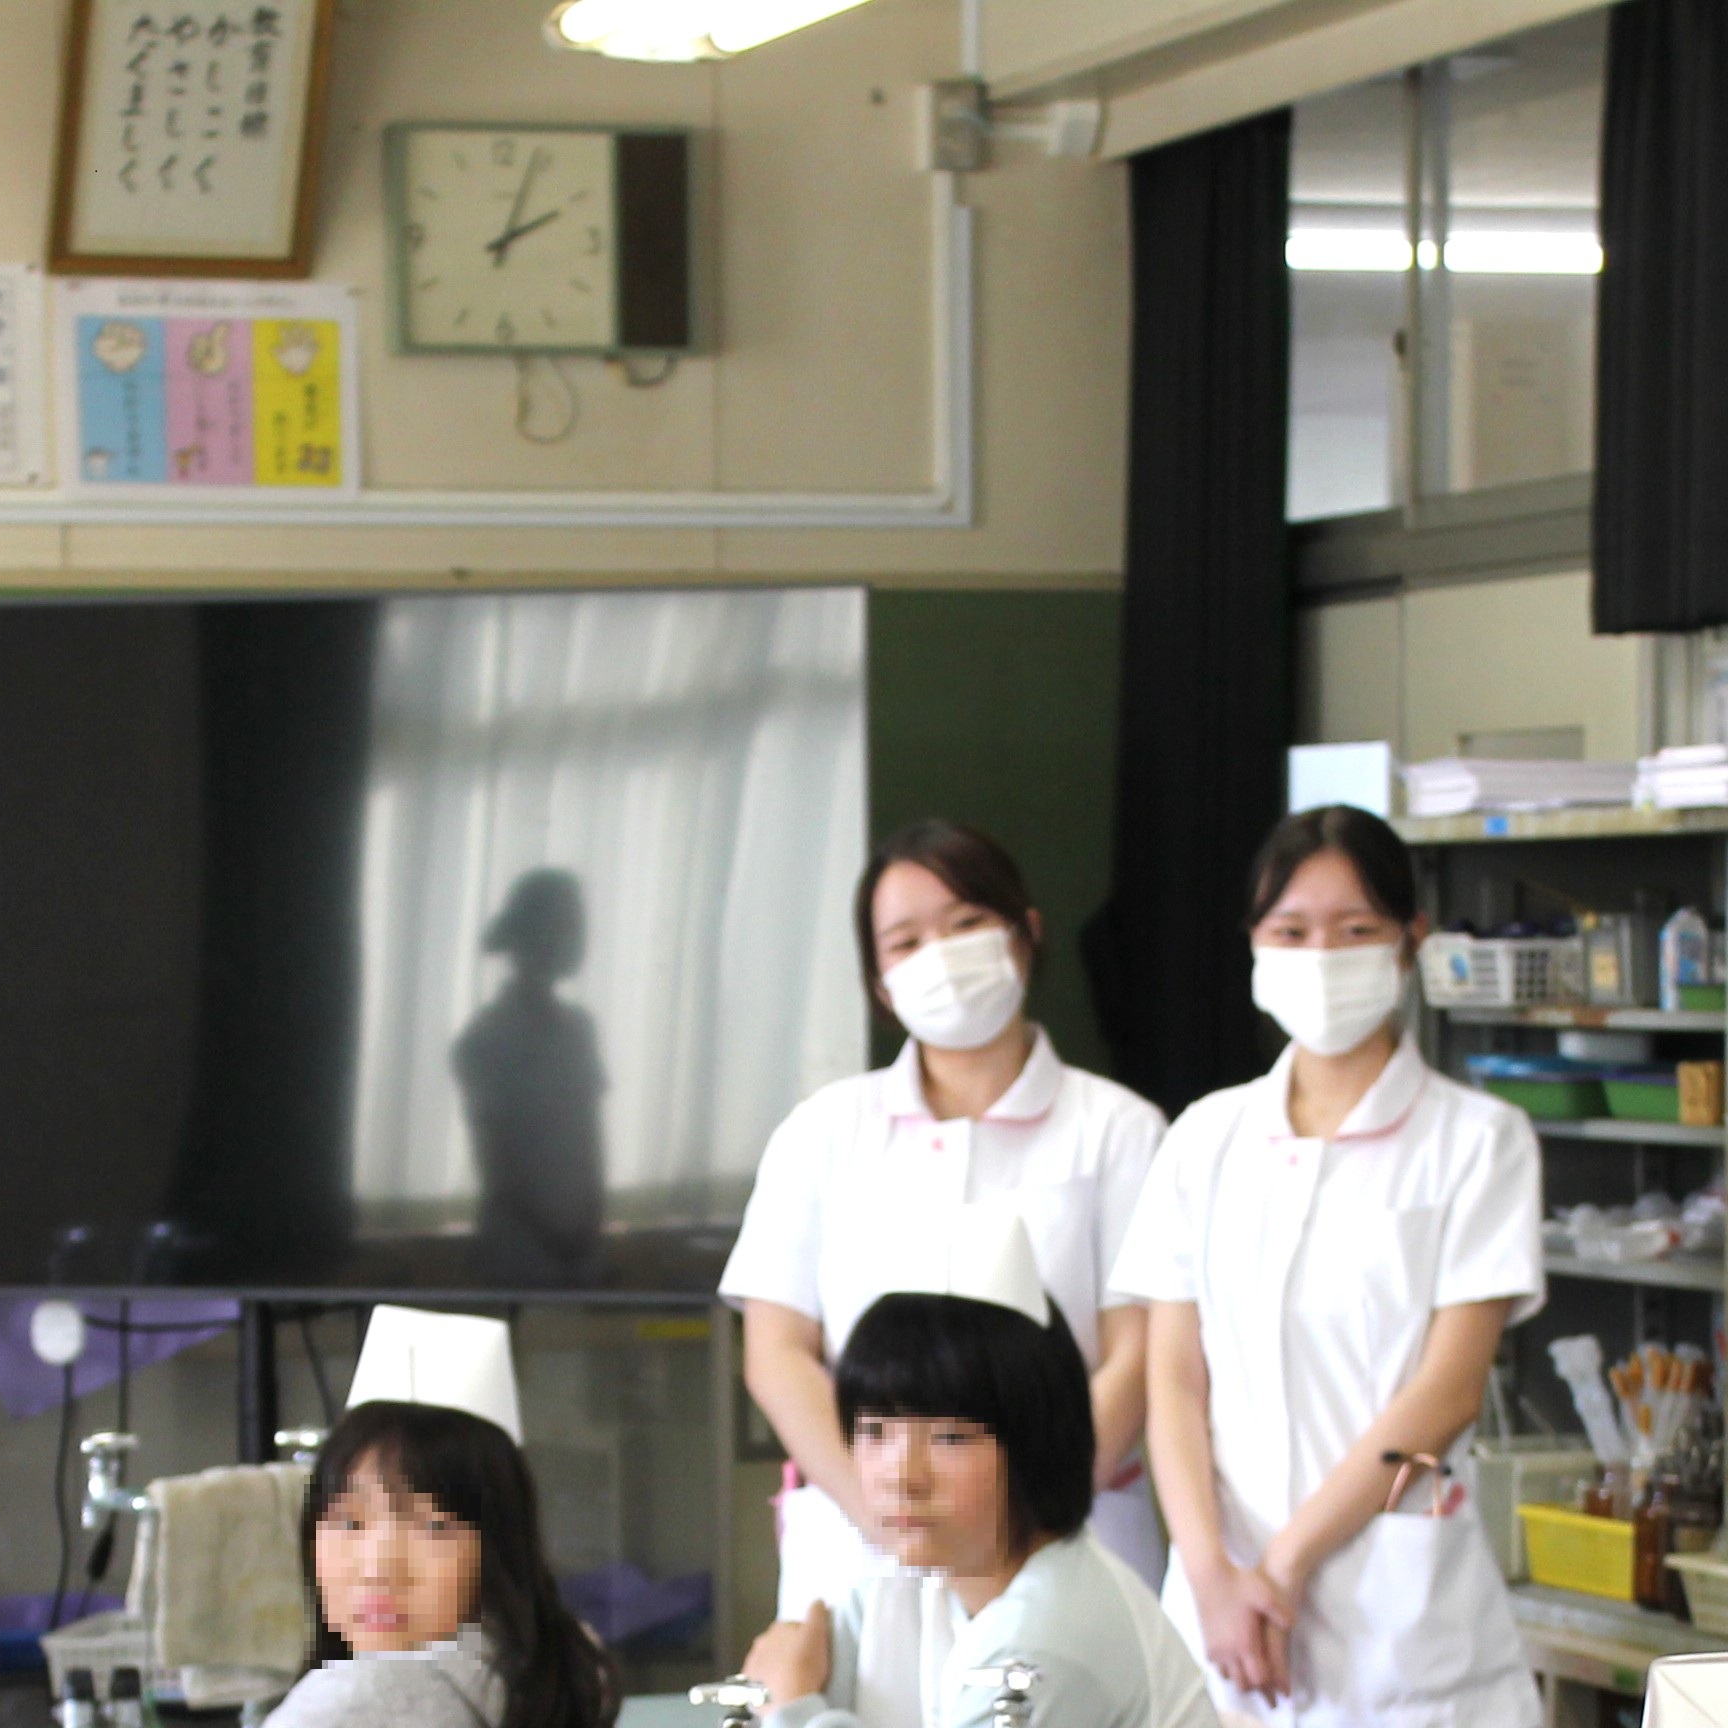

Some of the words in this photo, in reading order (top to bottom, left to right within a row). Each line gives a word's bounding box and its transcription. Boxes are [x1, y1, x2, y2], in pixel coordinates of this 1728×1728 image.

[118, 12, 159, 193] たくましく
[159, 14, 200, 190] やさしく
[193, 12, 242, 193] かしこく
